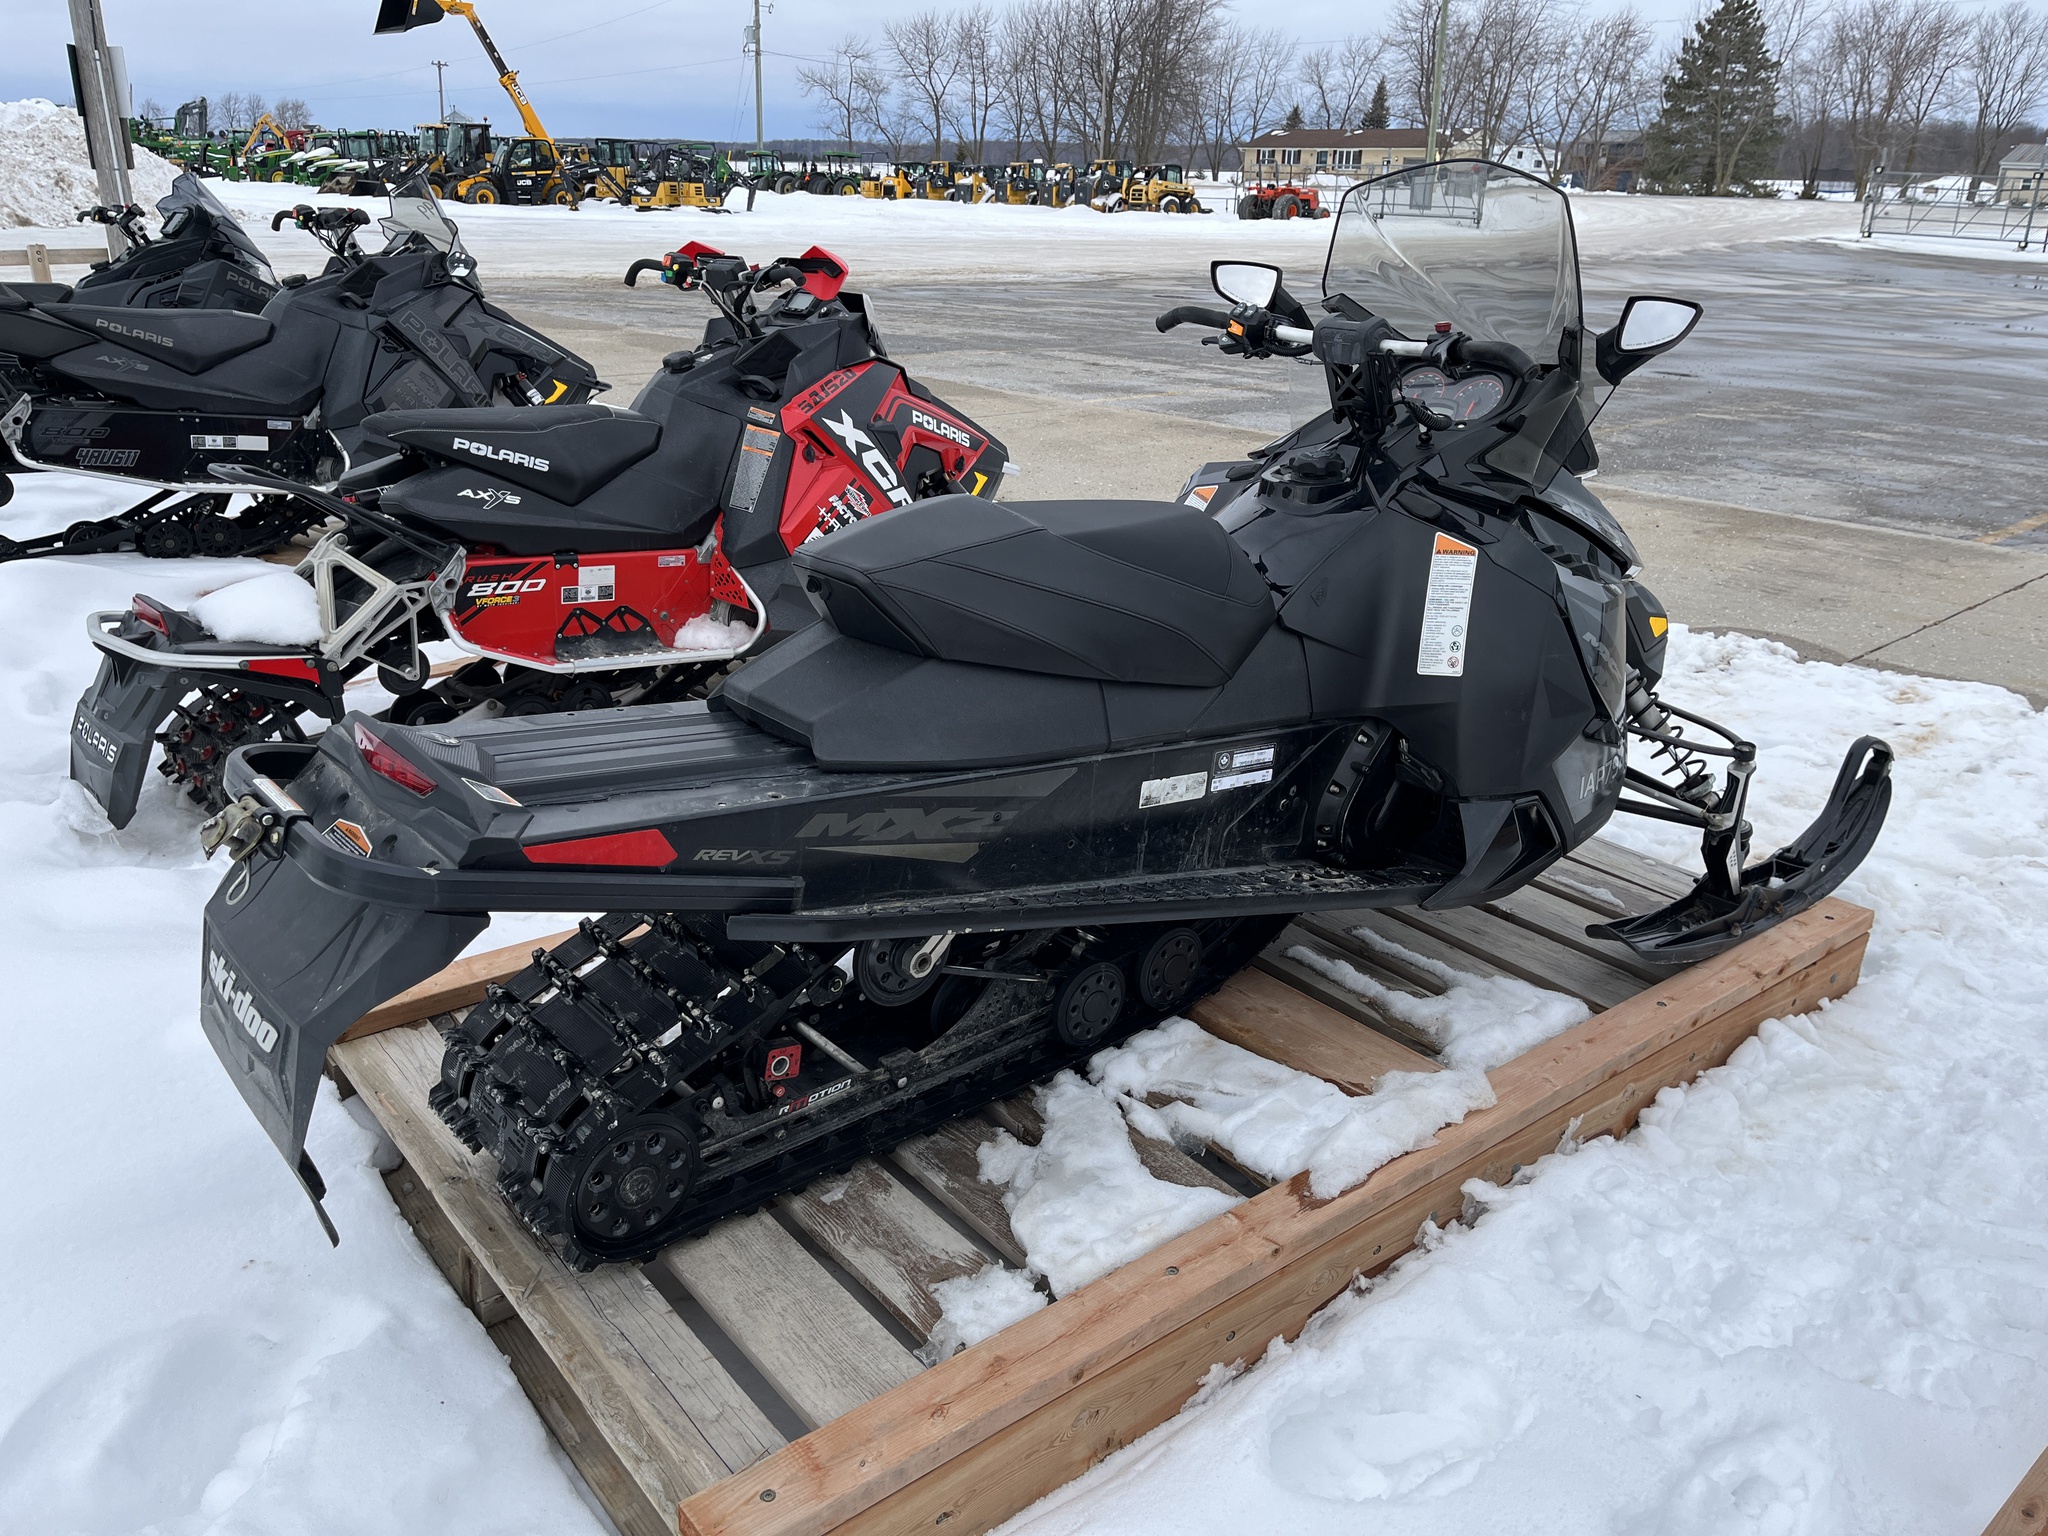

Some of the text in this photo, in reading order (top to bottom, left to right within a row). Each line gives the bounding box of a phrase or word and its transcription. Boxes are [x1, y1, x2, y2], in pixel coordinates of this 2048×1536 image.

[511, 83, 529, 106] JCB
[95, 318, 174, 348] POLARIS
[463, 313, 553, 366] XCR
[96, 355, 149, 373] AXYS
[912, 410, 970, 448] POLARIS
[452, 437, 550, 472] POLARIS
[457, 488, 522, 510] AXYS
[828, 494, 857, 524] FACTO
[464, 573, 514, 583] RUSH
[467, 579, 547, 597] 800
[77, 716, 117, 763] POLARIS
[794, 807, 1020, 842] MXZ
[209, 949, 279, 1053] ski-doo
